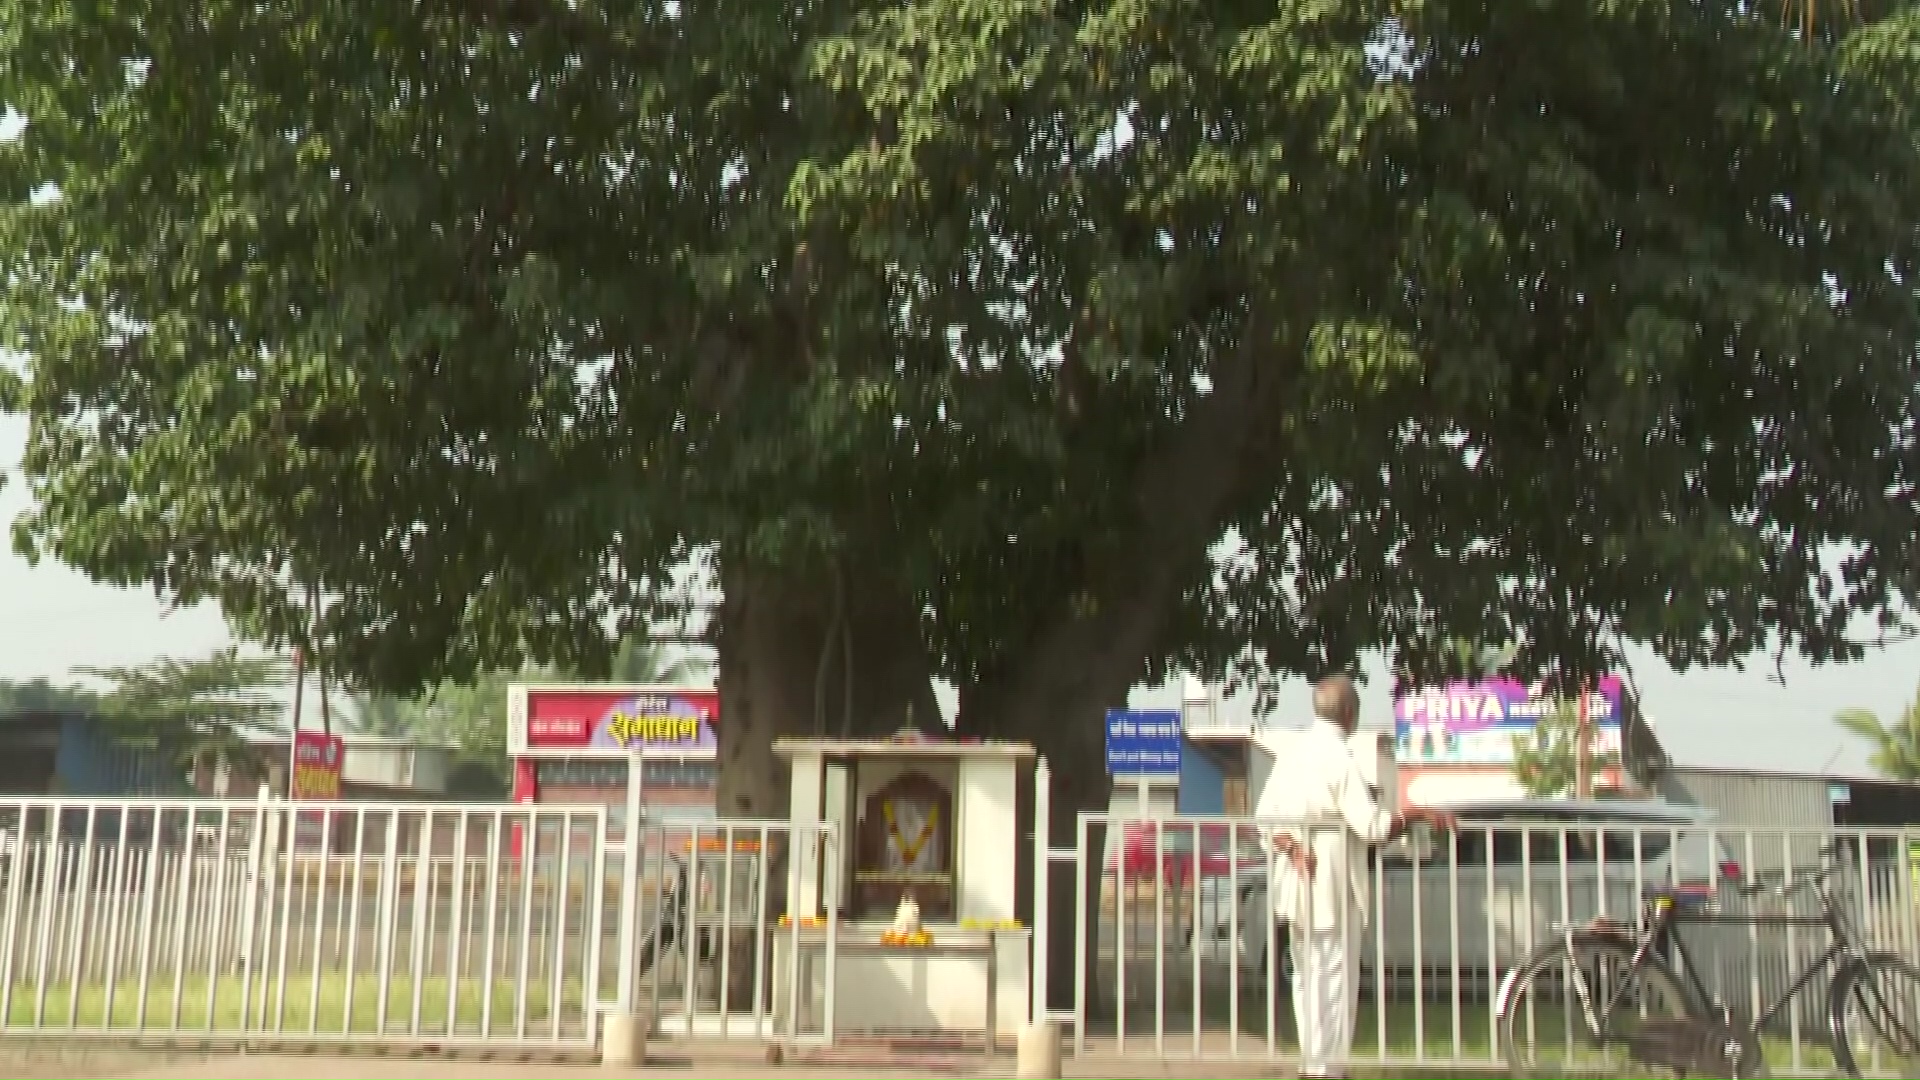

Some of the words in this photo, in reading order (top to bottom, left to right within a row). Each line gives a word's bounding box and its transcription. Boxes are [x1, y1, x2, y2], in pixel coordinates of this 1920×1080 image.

[1405, 694, 1504, 720] PRIYA
[1509, 702, 1612, 718] RESTANT
[608, 710, 697, 748] समाधान
